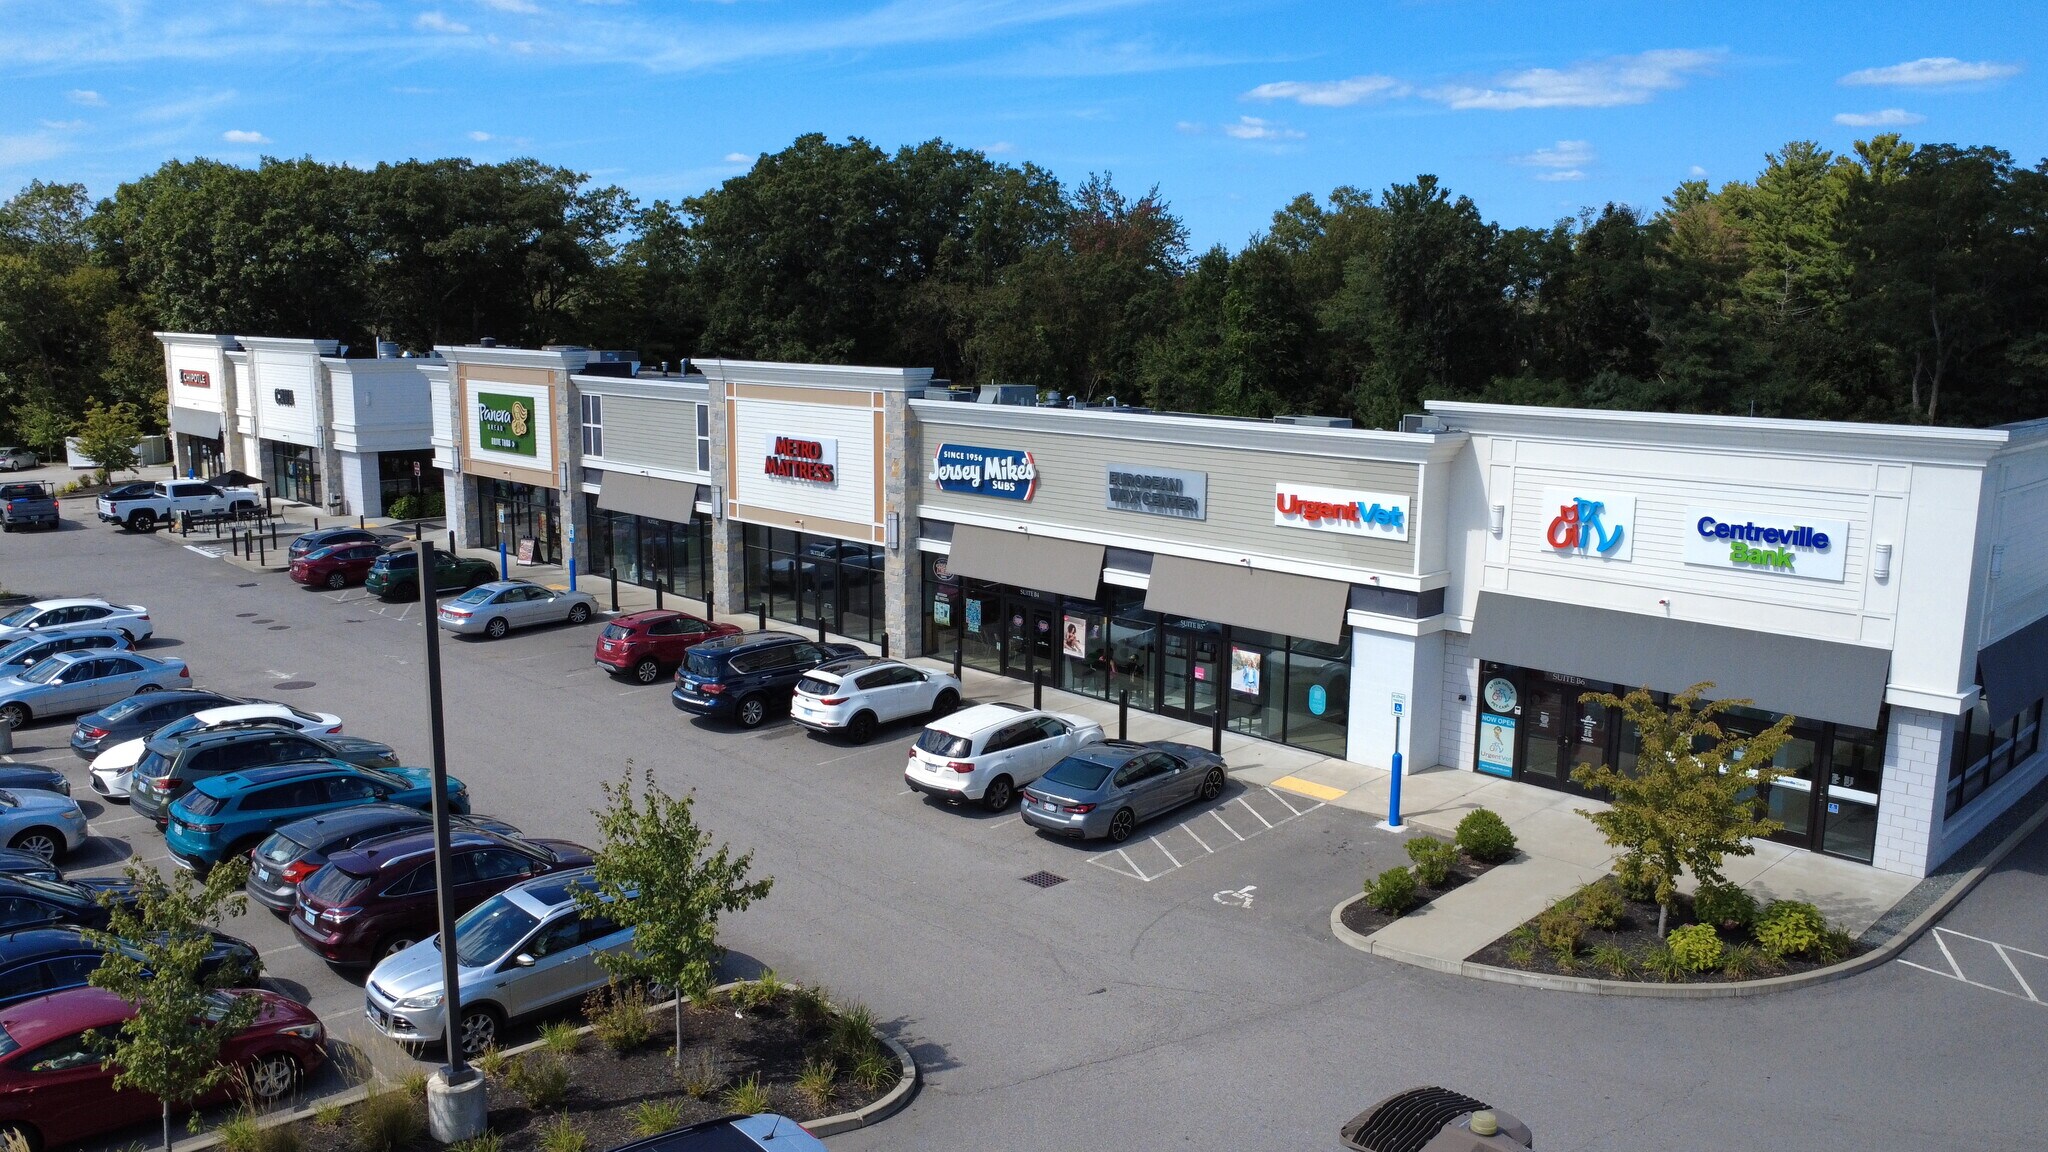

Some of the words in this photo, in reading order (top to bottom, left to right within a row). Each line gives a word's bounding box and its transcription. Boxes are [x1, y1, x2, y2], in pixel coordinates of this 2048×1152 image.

[183, 372, 206, 384] CHIPOTLE
[478, 403, 511, 423] Panera
[774, 436, 823, 460] METRO
[943, 451, 964, 460] SINCE
[966, 453, 983, 462] 1956
[764, 456, 835, 483] MATTRESS
[928, 458, 981, 487] Jersey
[984, 456, 1035, 481] Mike's
[1109, 471, 1184, 492] EUROPEAN
[1109, 488, 1142, 504] WAX
[1142, 491, 1199, 512] CENTER
[1276, 493, 1404, 527] UrgentVet
[1697, 516, 1829, 549] Centreville
[1729, 541, 1795, 569] Bank
[1180, 619, 1197, 629] SUITE
[1552, 673, 1575, 684] SUITE
[1576, 678, 1586, 686] B6
[1482, 715, 1497, 723] NOW
[1497, 718, 1515, 727] OPEN
